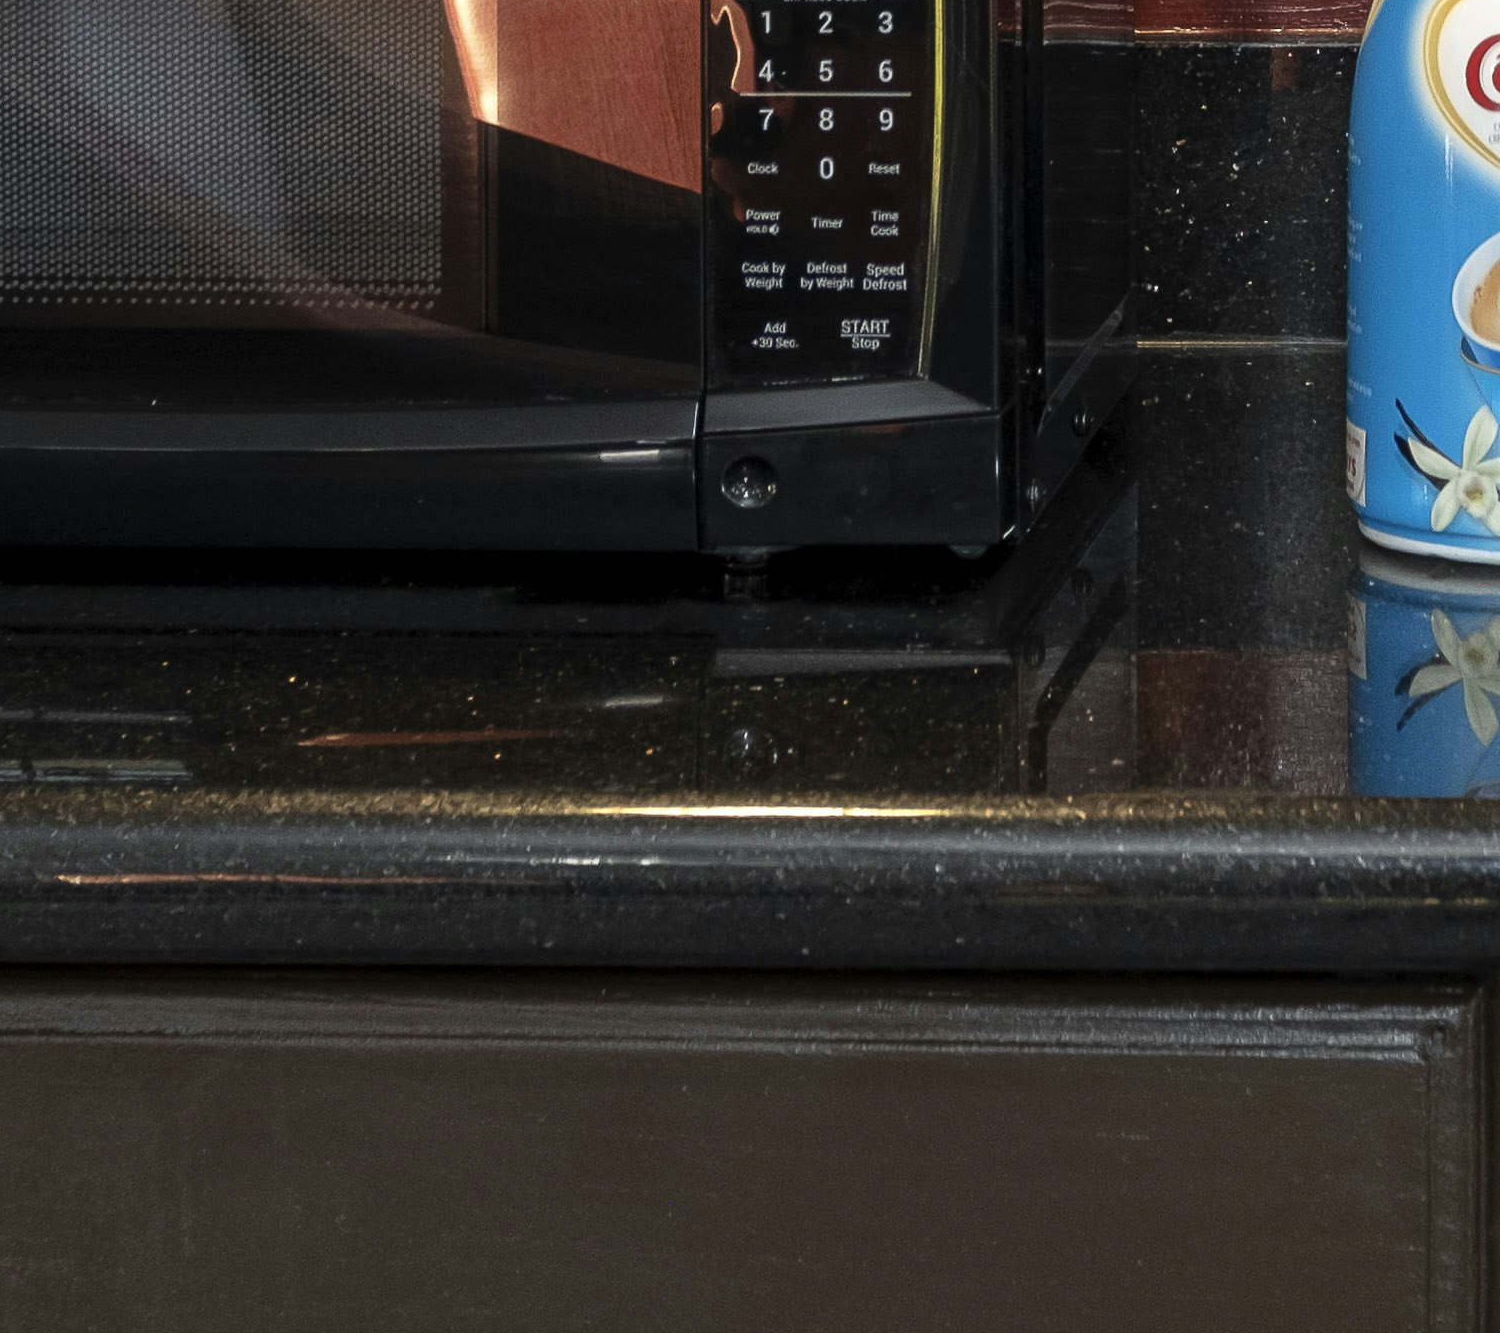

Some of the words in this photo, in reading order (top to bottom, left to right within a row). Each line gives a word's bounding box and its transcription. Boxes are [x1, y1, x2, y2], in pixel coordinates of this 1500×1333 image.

[761, 10, 772, 34] 1
[818, 10, 834, 34] 2
[878, 10, 893, 34] 3
[758, 59, 773, 82] 4
[819, 59, 834, 82] 5
[878, 59, 893, 82] 6
[758, 108, 774, 130] 7
[819, 108, 834, 130] 8
[879, 108, 893, 130] 9
[747, 162, 778, 174] Clock
[819, 156, 834, 179] 0
[868, 163, 900, 174] Reset
[746, 209, 780, 221] Power
[871, 210, 899, 221] Time
[811, 217, 843, 229] Timer
[870, 225, 899, 236] Cook
[741, 262, 769, 274] Cook
[772, 262, 786, 276] by
[806, 262, 847, 274] Defrost
[866, 263, 904, 277] Speed
[745, 277, 783, 291] Weight
[800, 277, 814, 290] by
[816, 277, 854, 291] Weight
[862, 278, 907, 291] Defrost
[764, 322, 786, 333] Add
[841, 319, 890, 334] START
[775, 337, 799, 349] Sec.
[851, 337, 880, 350] Stop
